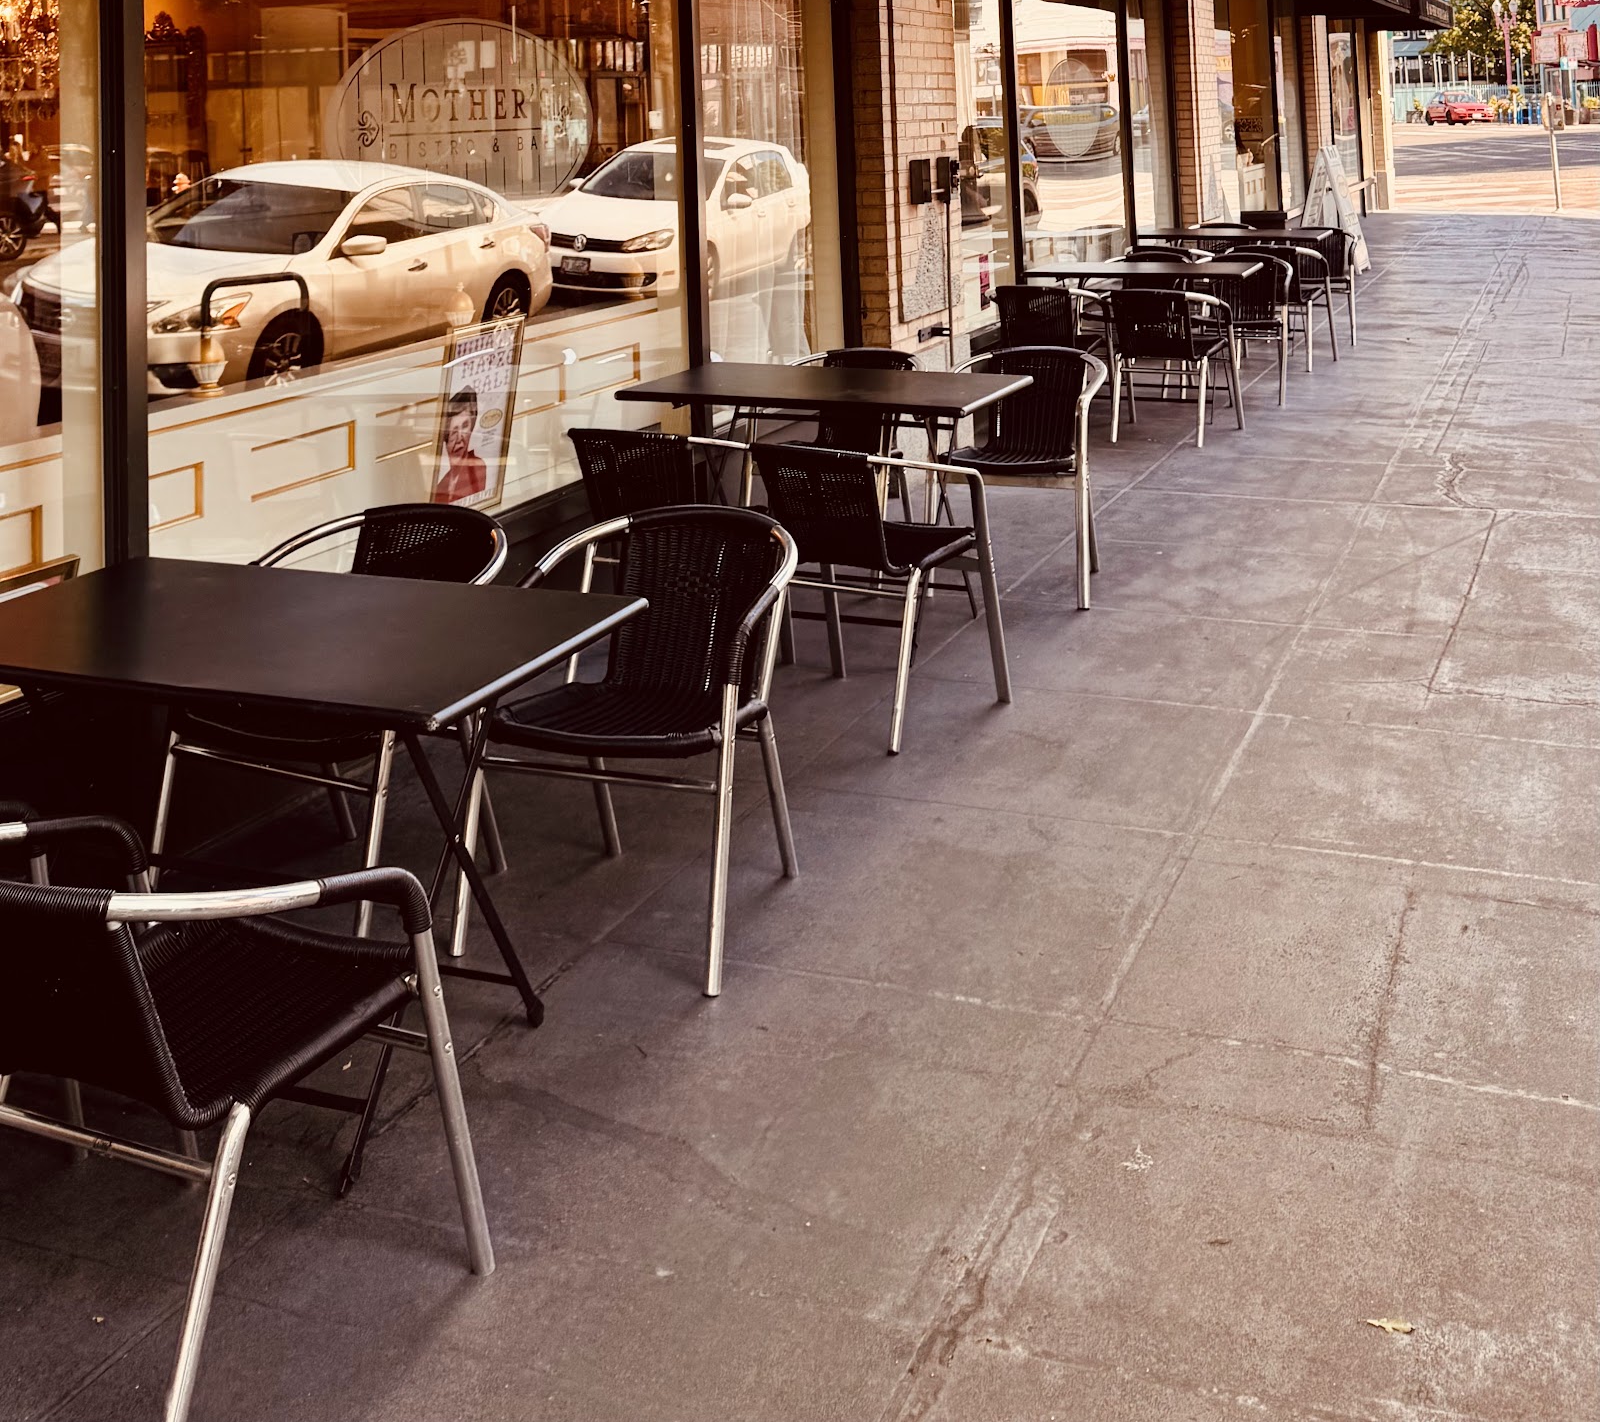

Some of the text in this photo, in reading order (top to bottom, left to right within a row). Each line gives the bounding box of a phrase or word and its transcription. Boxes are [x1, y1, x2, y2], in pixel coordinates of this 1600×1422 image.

[389, 134, 550, 160] BISTRO & BA
